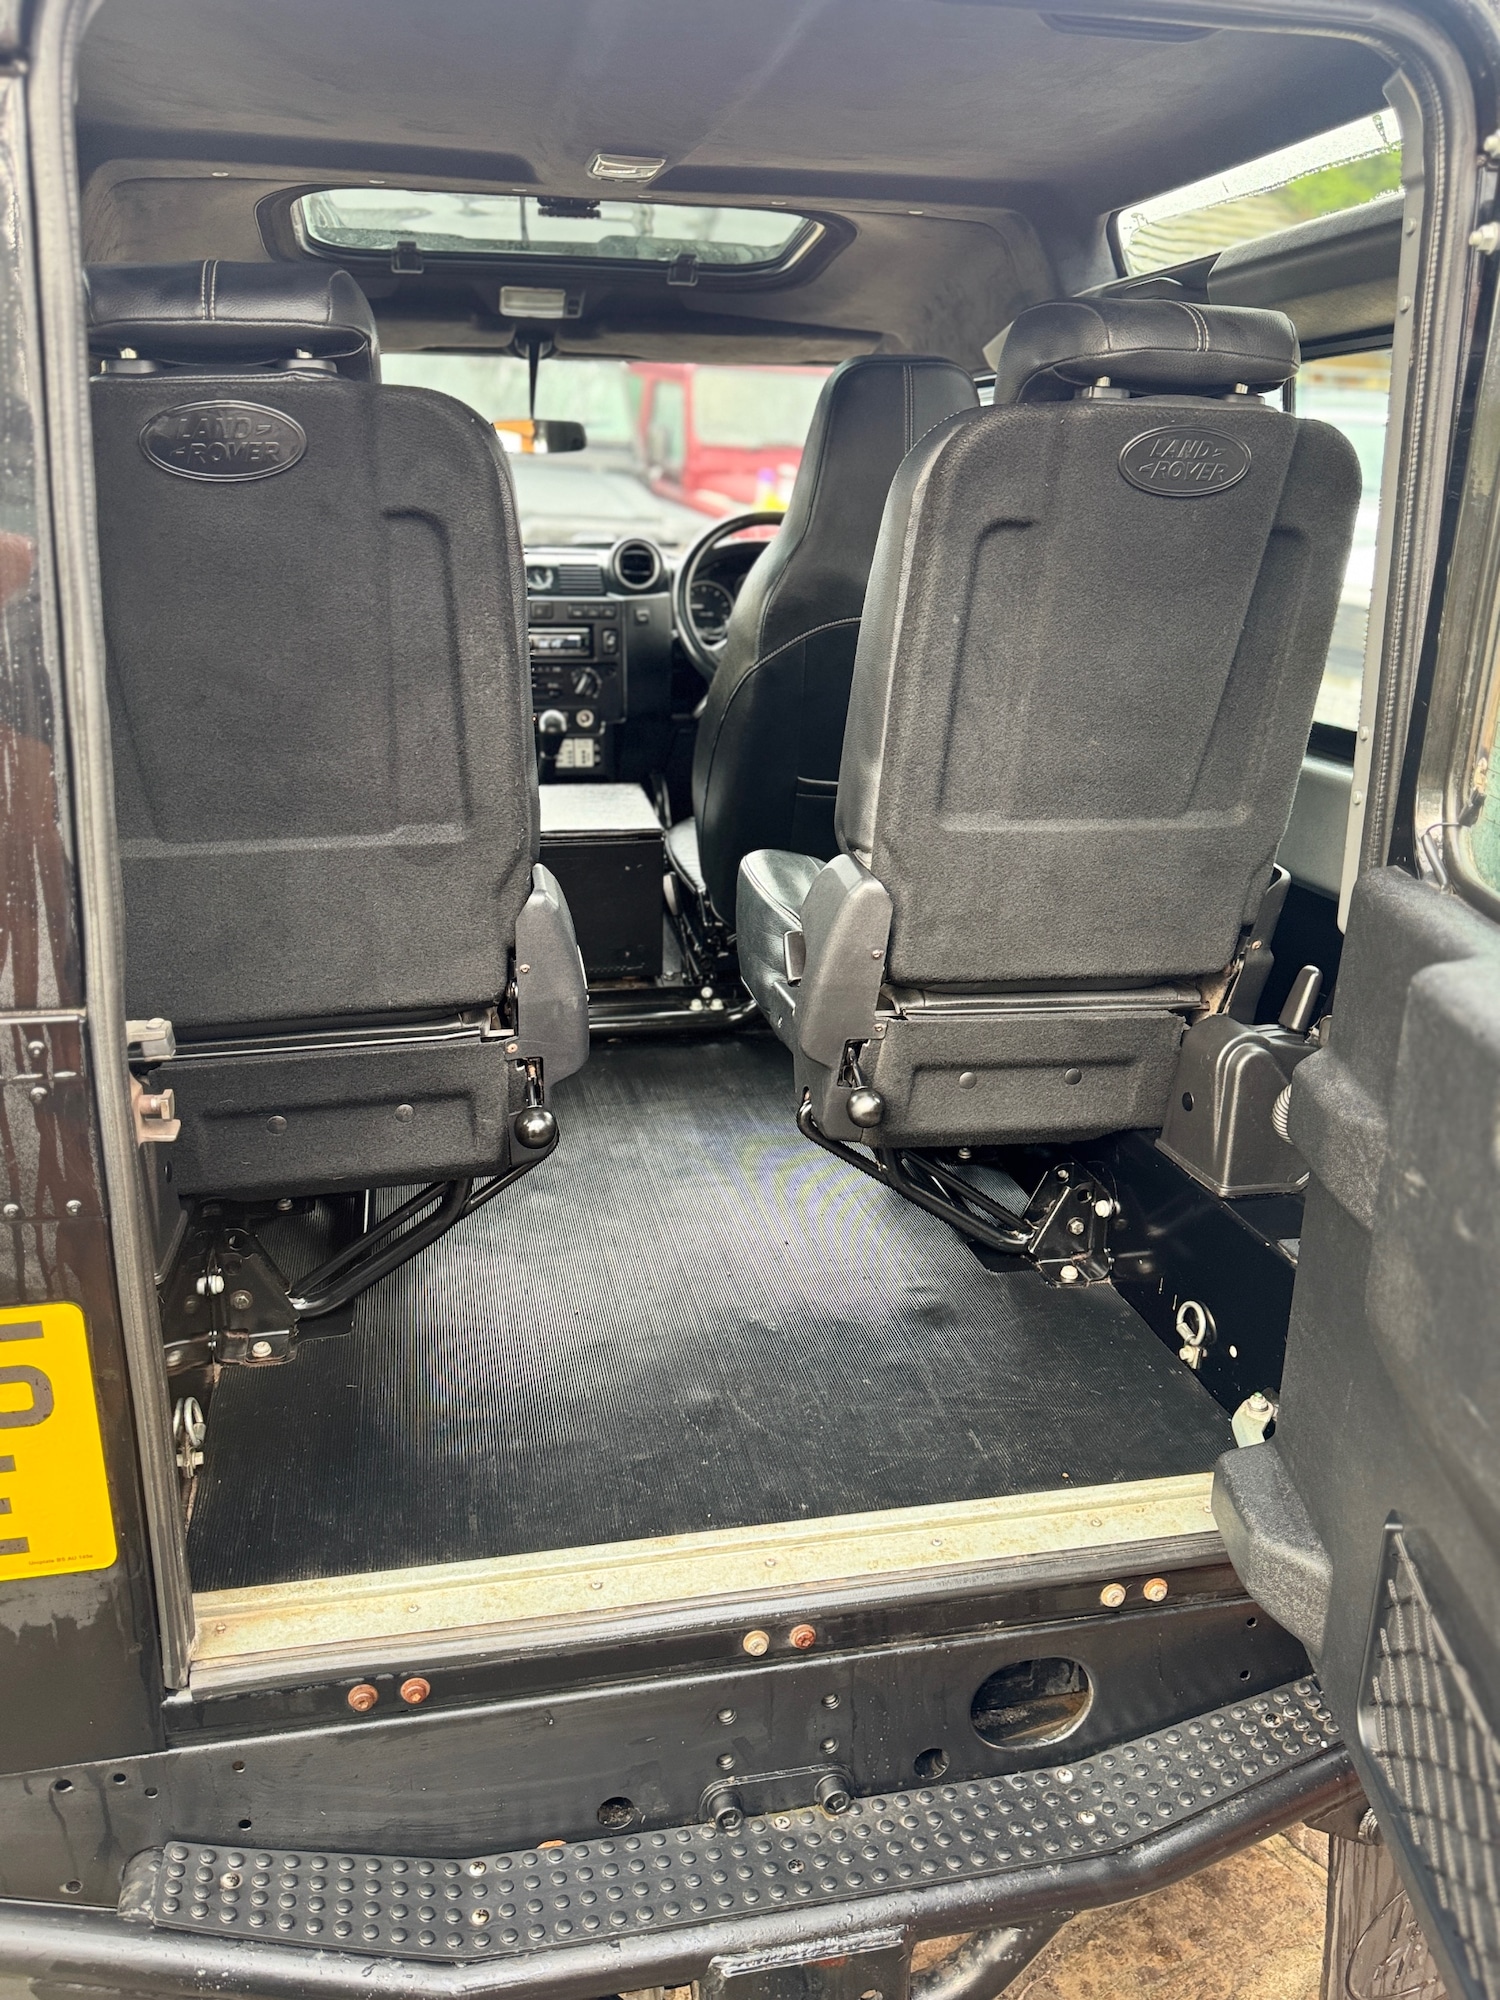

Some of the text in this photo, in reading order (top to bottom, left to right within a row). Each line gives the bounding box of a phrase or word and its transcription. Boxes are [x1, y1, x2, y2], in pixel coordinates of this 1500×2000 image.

[176, 416, 251, 440] LAND
[187, 441, 280, 464] ROVER
[1149, 438, 1214, 459] LAND
[1150, 460, 1229, 482] ROVER
